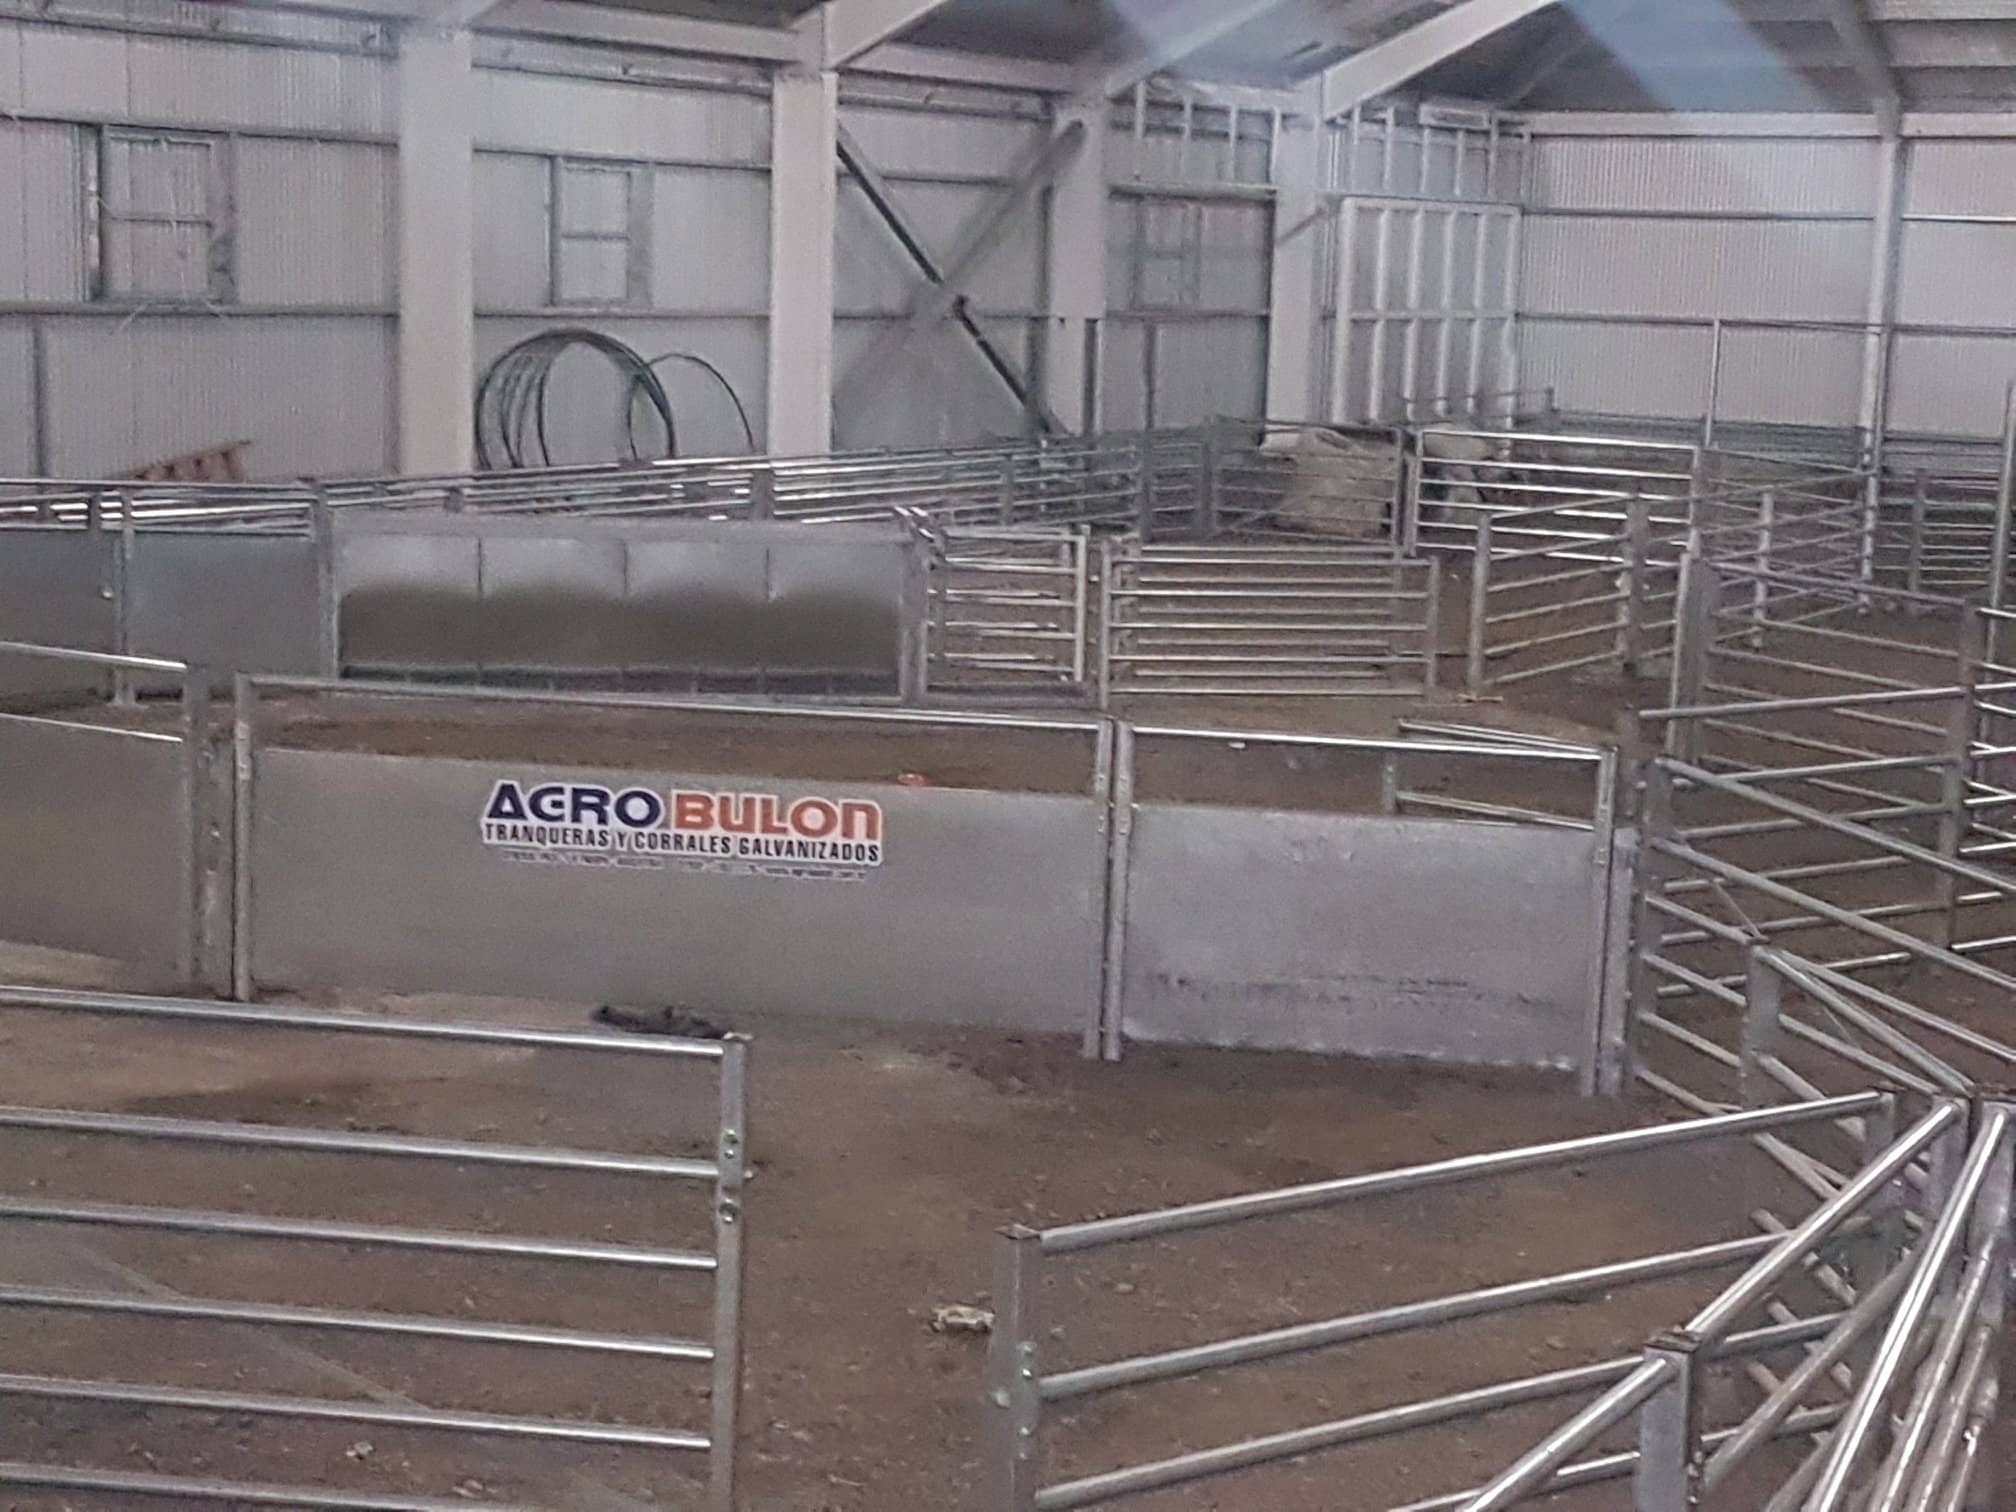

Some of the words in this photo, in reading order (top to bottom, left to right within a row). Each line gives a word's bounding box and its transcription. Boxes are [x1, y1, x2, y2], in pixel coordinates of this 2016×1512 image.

[485, 824, 608, 847] TRANQUERAS
[616, 832, 626, 848] Y
[634, 832, 731, 854] CORRALES
[738, 838, 879, 862] GALVANIZADOS
